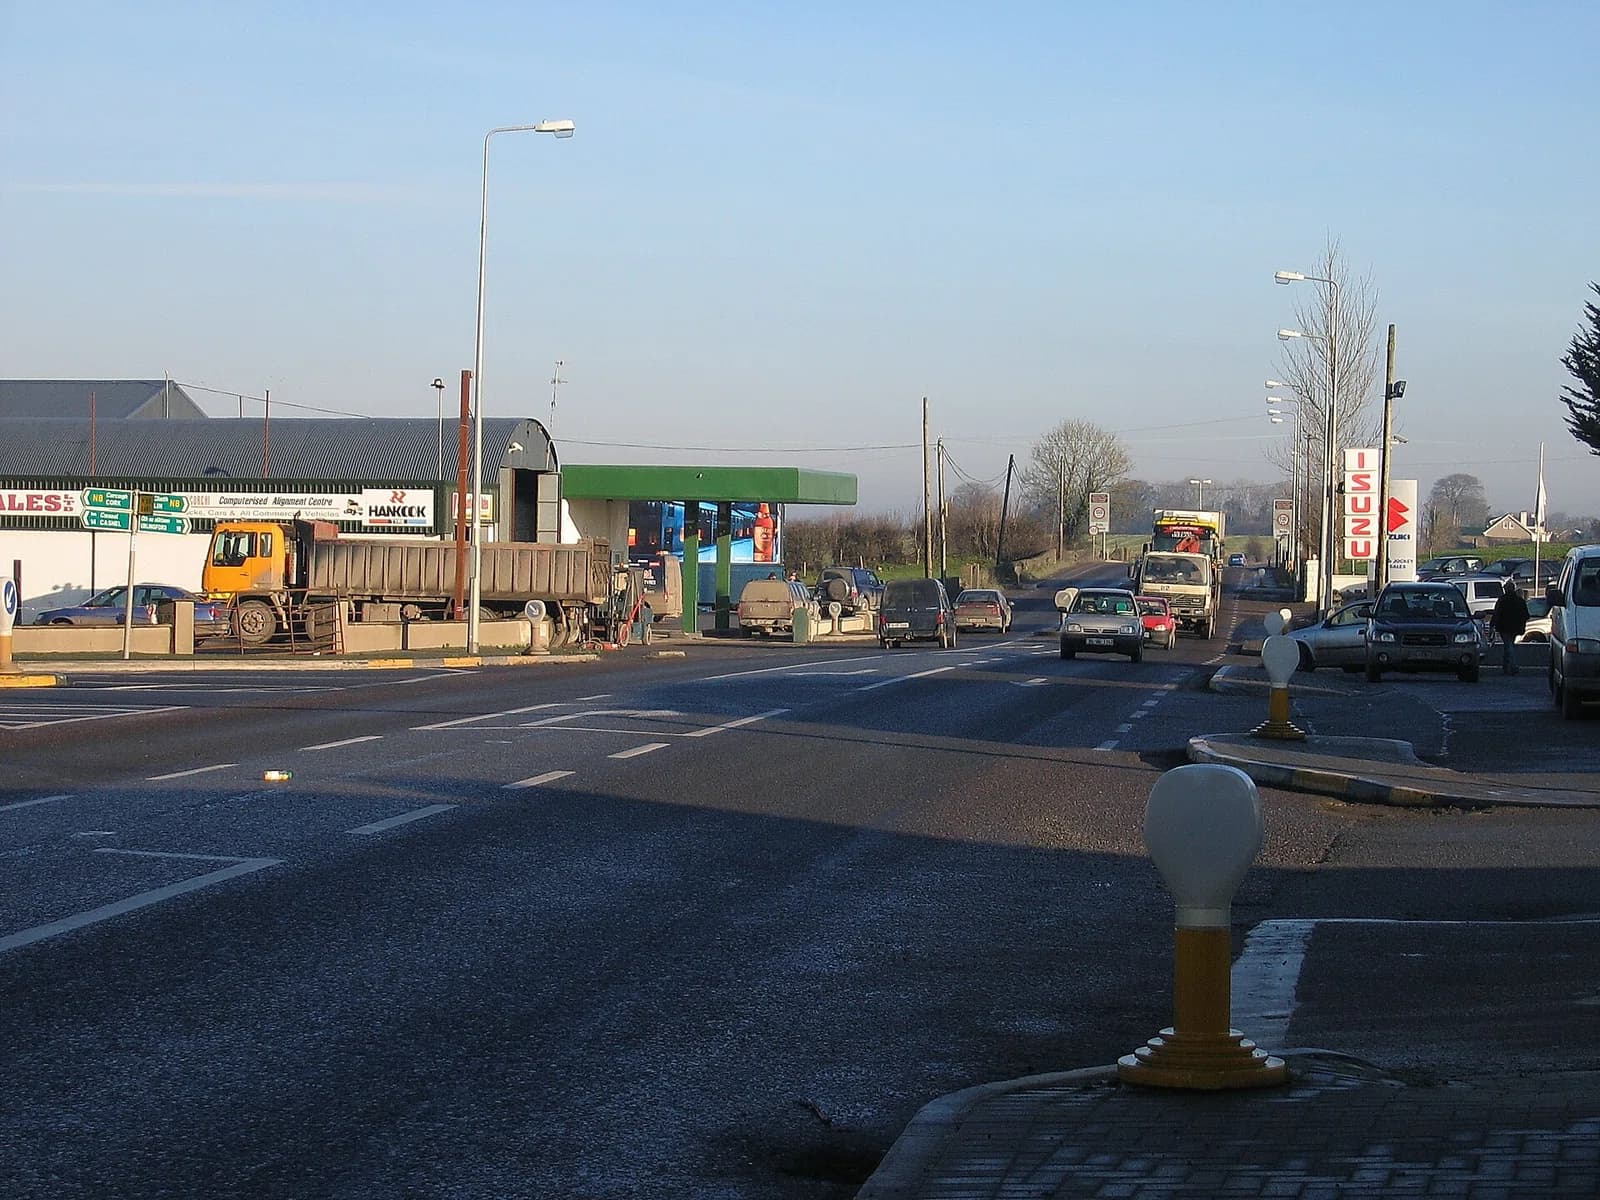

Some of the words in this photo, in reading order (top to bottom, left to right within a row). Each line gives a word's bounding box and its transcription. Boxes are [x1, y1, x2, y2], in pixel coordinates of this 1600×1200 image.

[92, 494, 104, 503] N8
[219, 496, 268, 506] Computerised
[272, 496, 306, 507] Alignment
[308, 497, 333, 506] Centre
[153, 502, 163, 510] LIN
[169, 499, 181, 508] N8
[1351, 452, 1371, 557] ISUZU
[207, 509, 227, 517] Cars
[368, 505, 427, 517] HANKOOK
[100, 519, 122, 528] CASHEL
